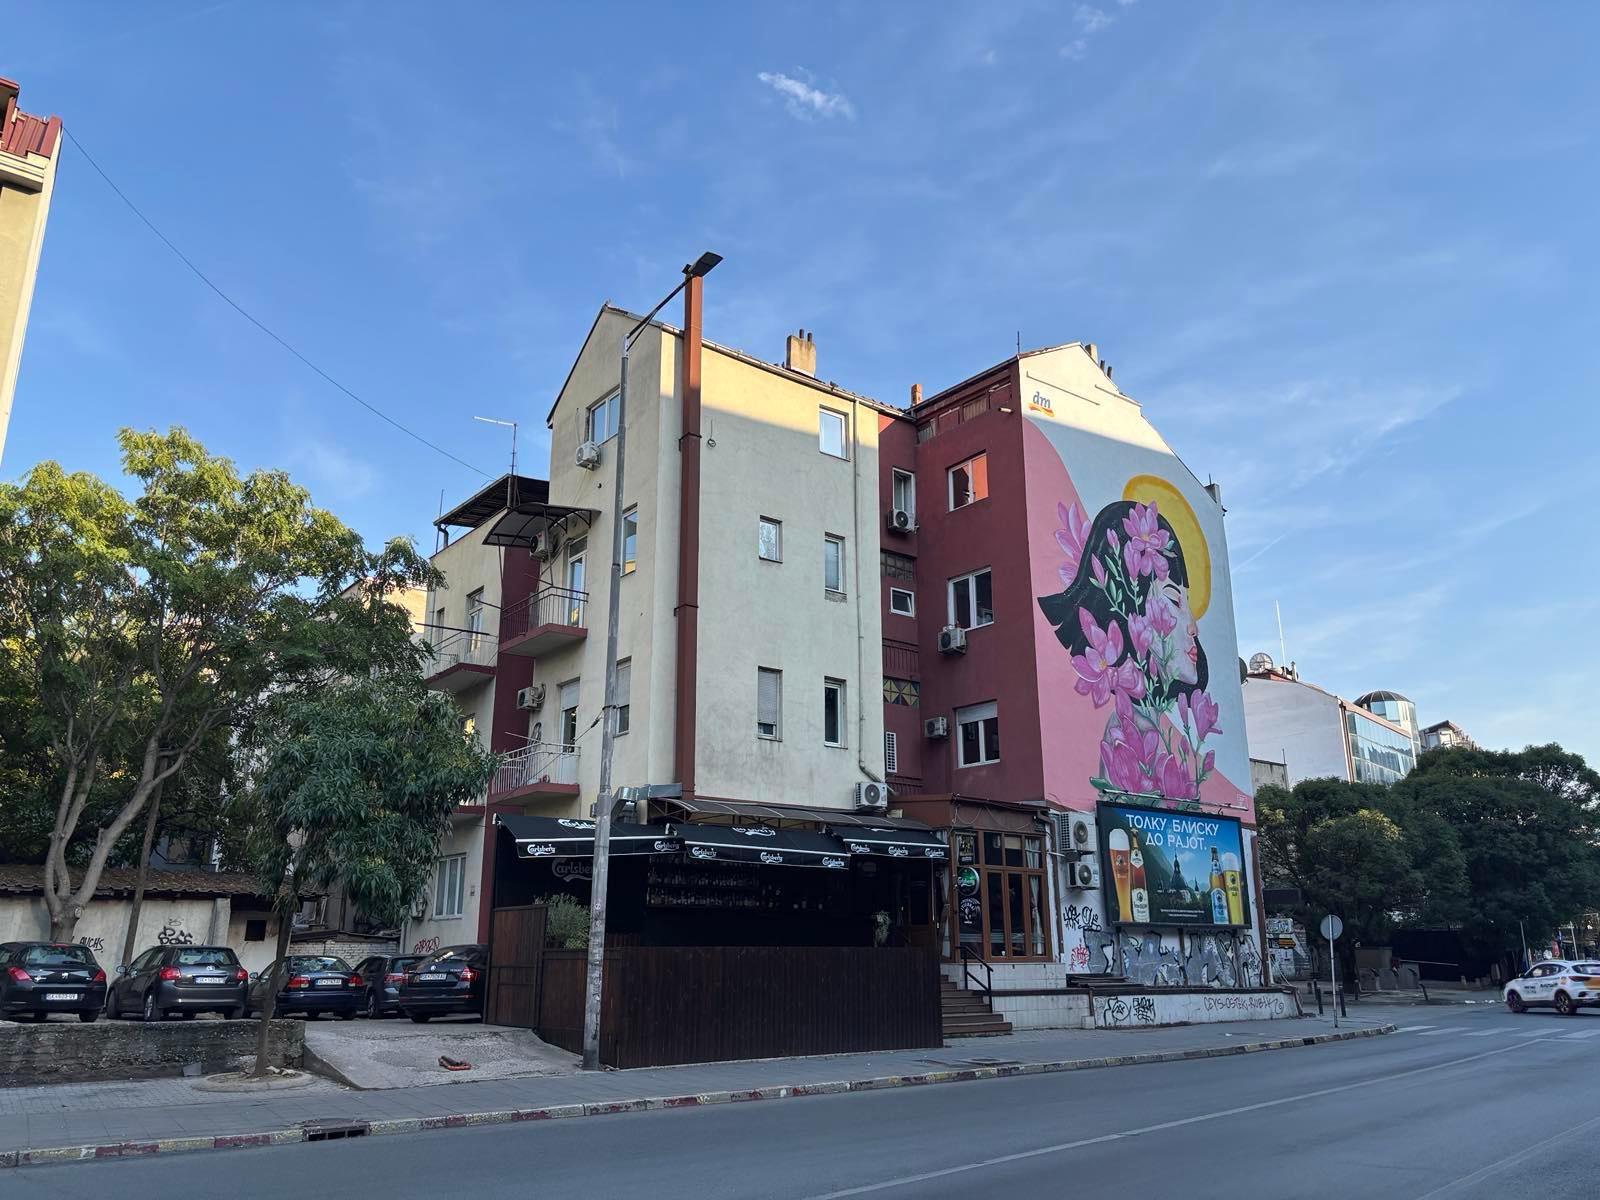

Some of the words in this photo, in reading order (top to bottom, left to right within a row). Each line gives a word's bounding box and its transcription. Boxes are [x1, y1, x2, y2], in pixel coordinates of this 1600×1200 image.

[1032, 391, 1051, 408] dm
[1125, 813, 1167, 831] ТОЛКУ
[1172, 819, 1220, 836] БЛИСКУ
[654, 840, 680, 852] Carlsberg
[1145, 832, 1163, 846] ДО
[1167, 834, 1208, 851] РАЈОТ.
[527, 843, 556, 855] Carlsberg
[692, 846, 717, 857] Carlsberg
[850, 843, 870, 854] Carlsberg
[888, 846, 909, 857] Carlsberg
[924, 847, 945, 858] Carlsberg
[760, 851, 783, 863] Carlsberg
[822, 856, 845, 868] Carlsberg
[551, 857, 593, 879] Carlsbe
